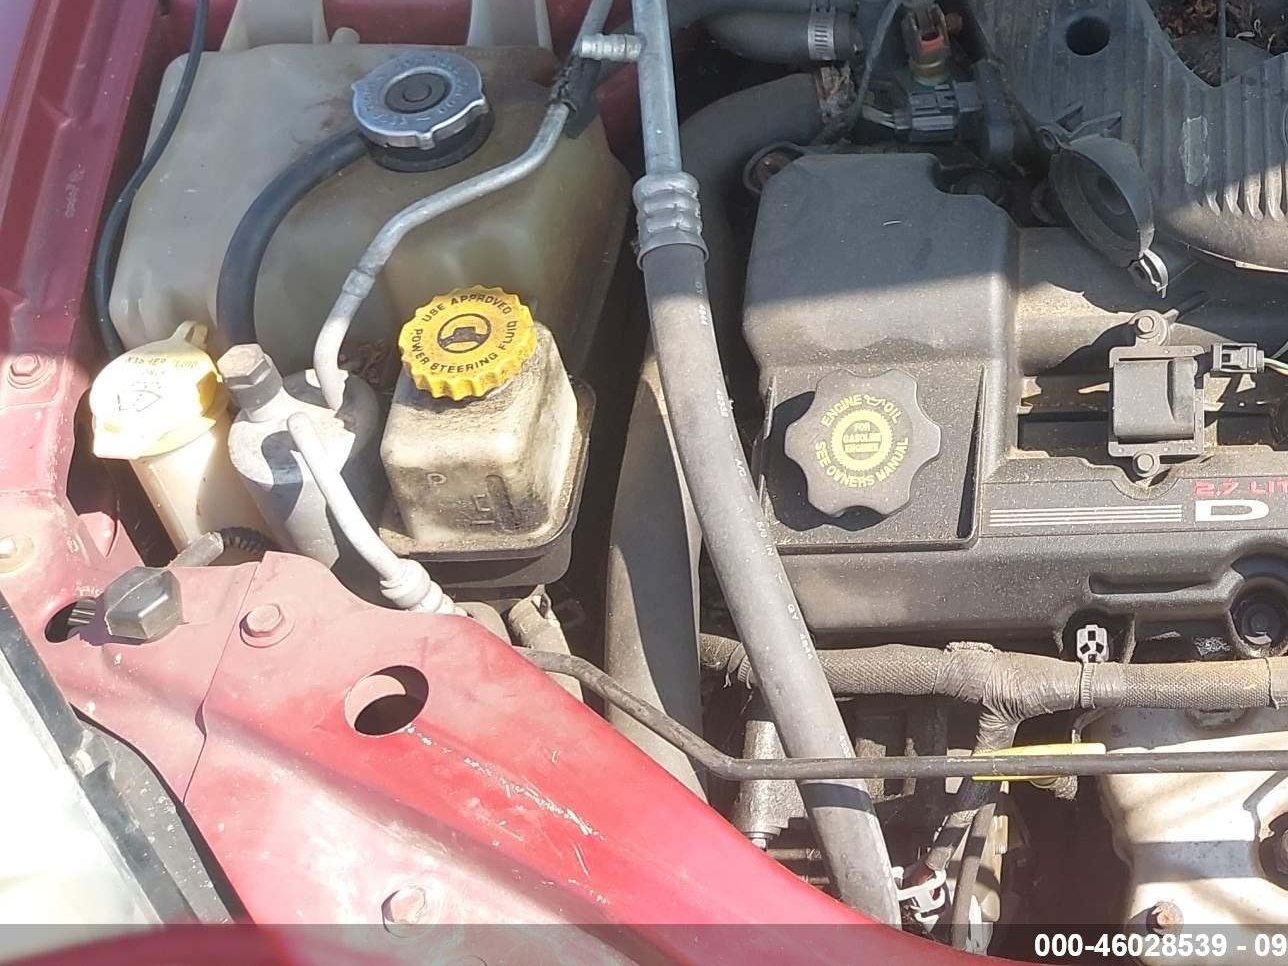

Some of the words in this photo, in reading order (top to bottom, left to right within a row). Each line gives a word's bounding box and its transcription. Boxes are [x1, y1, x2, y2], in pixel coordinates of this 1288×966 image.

[422, 302, 447, 323] USE
[450, 293, 513, 316] APPROVED
[411, 328, 431, 366] POWER
[430, 352, 499, 374] STEERING
[499, 320, 519, 351] FLUID
[820, 393, 863, 427] ENGINE
[883, 401, 904, 425] OIL
[853, 422, 871, 432] FOR
[815, 441, 832, 468] SEE
[826, 465, 876, 488] OWNERS
[875, 436, 909, 482] MANUAL
[1195, 478, 1240, 497] 2.7
